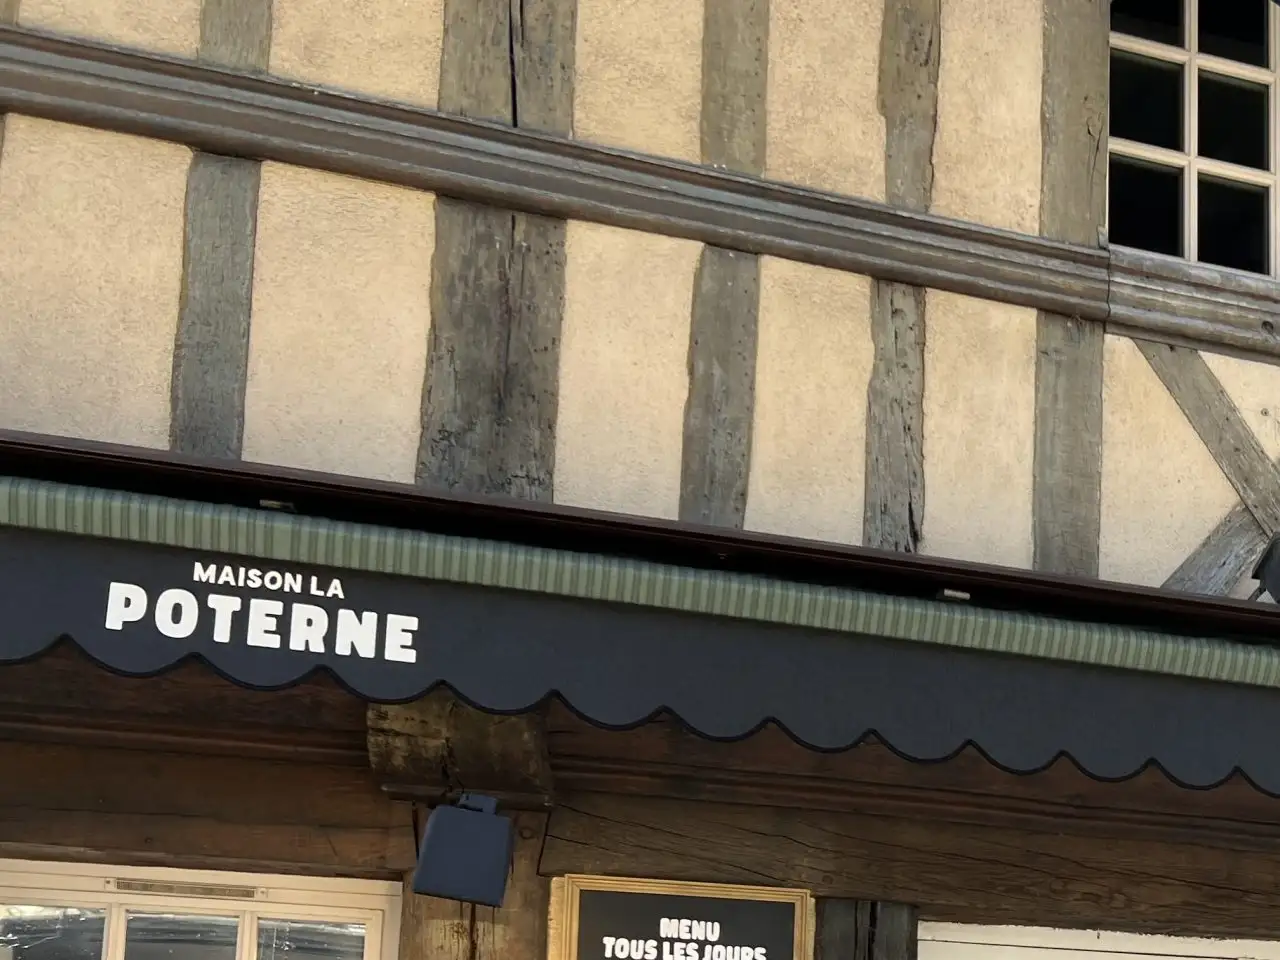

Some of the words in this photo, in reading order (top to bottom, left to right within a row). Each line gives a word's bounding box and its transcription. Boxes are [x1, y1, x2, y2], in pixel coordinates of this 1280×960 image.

[193, 562, 302, 593] MAISON
[310, 576, 345, 599] LA
[105, 582, 418, 663] POTERNE
[660, 918, 720, 941] MENU
[603, 937, 657, 960] TOUS
